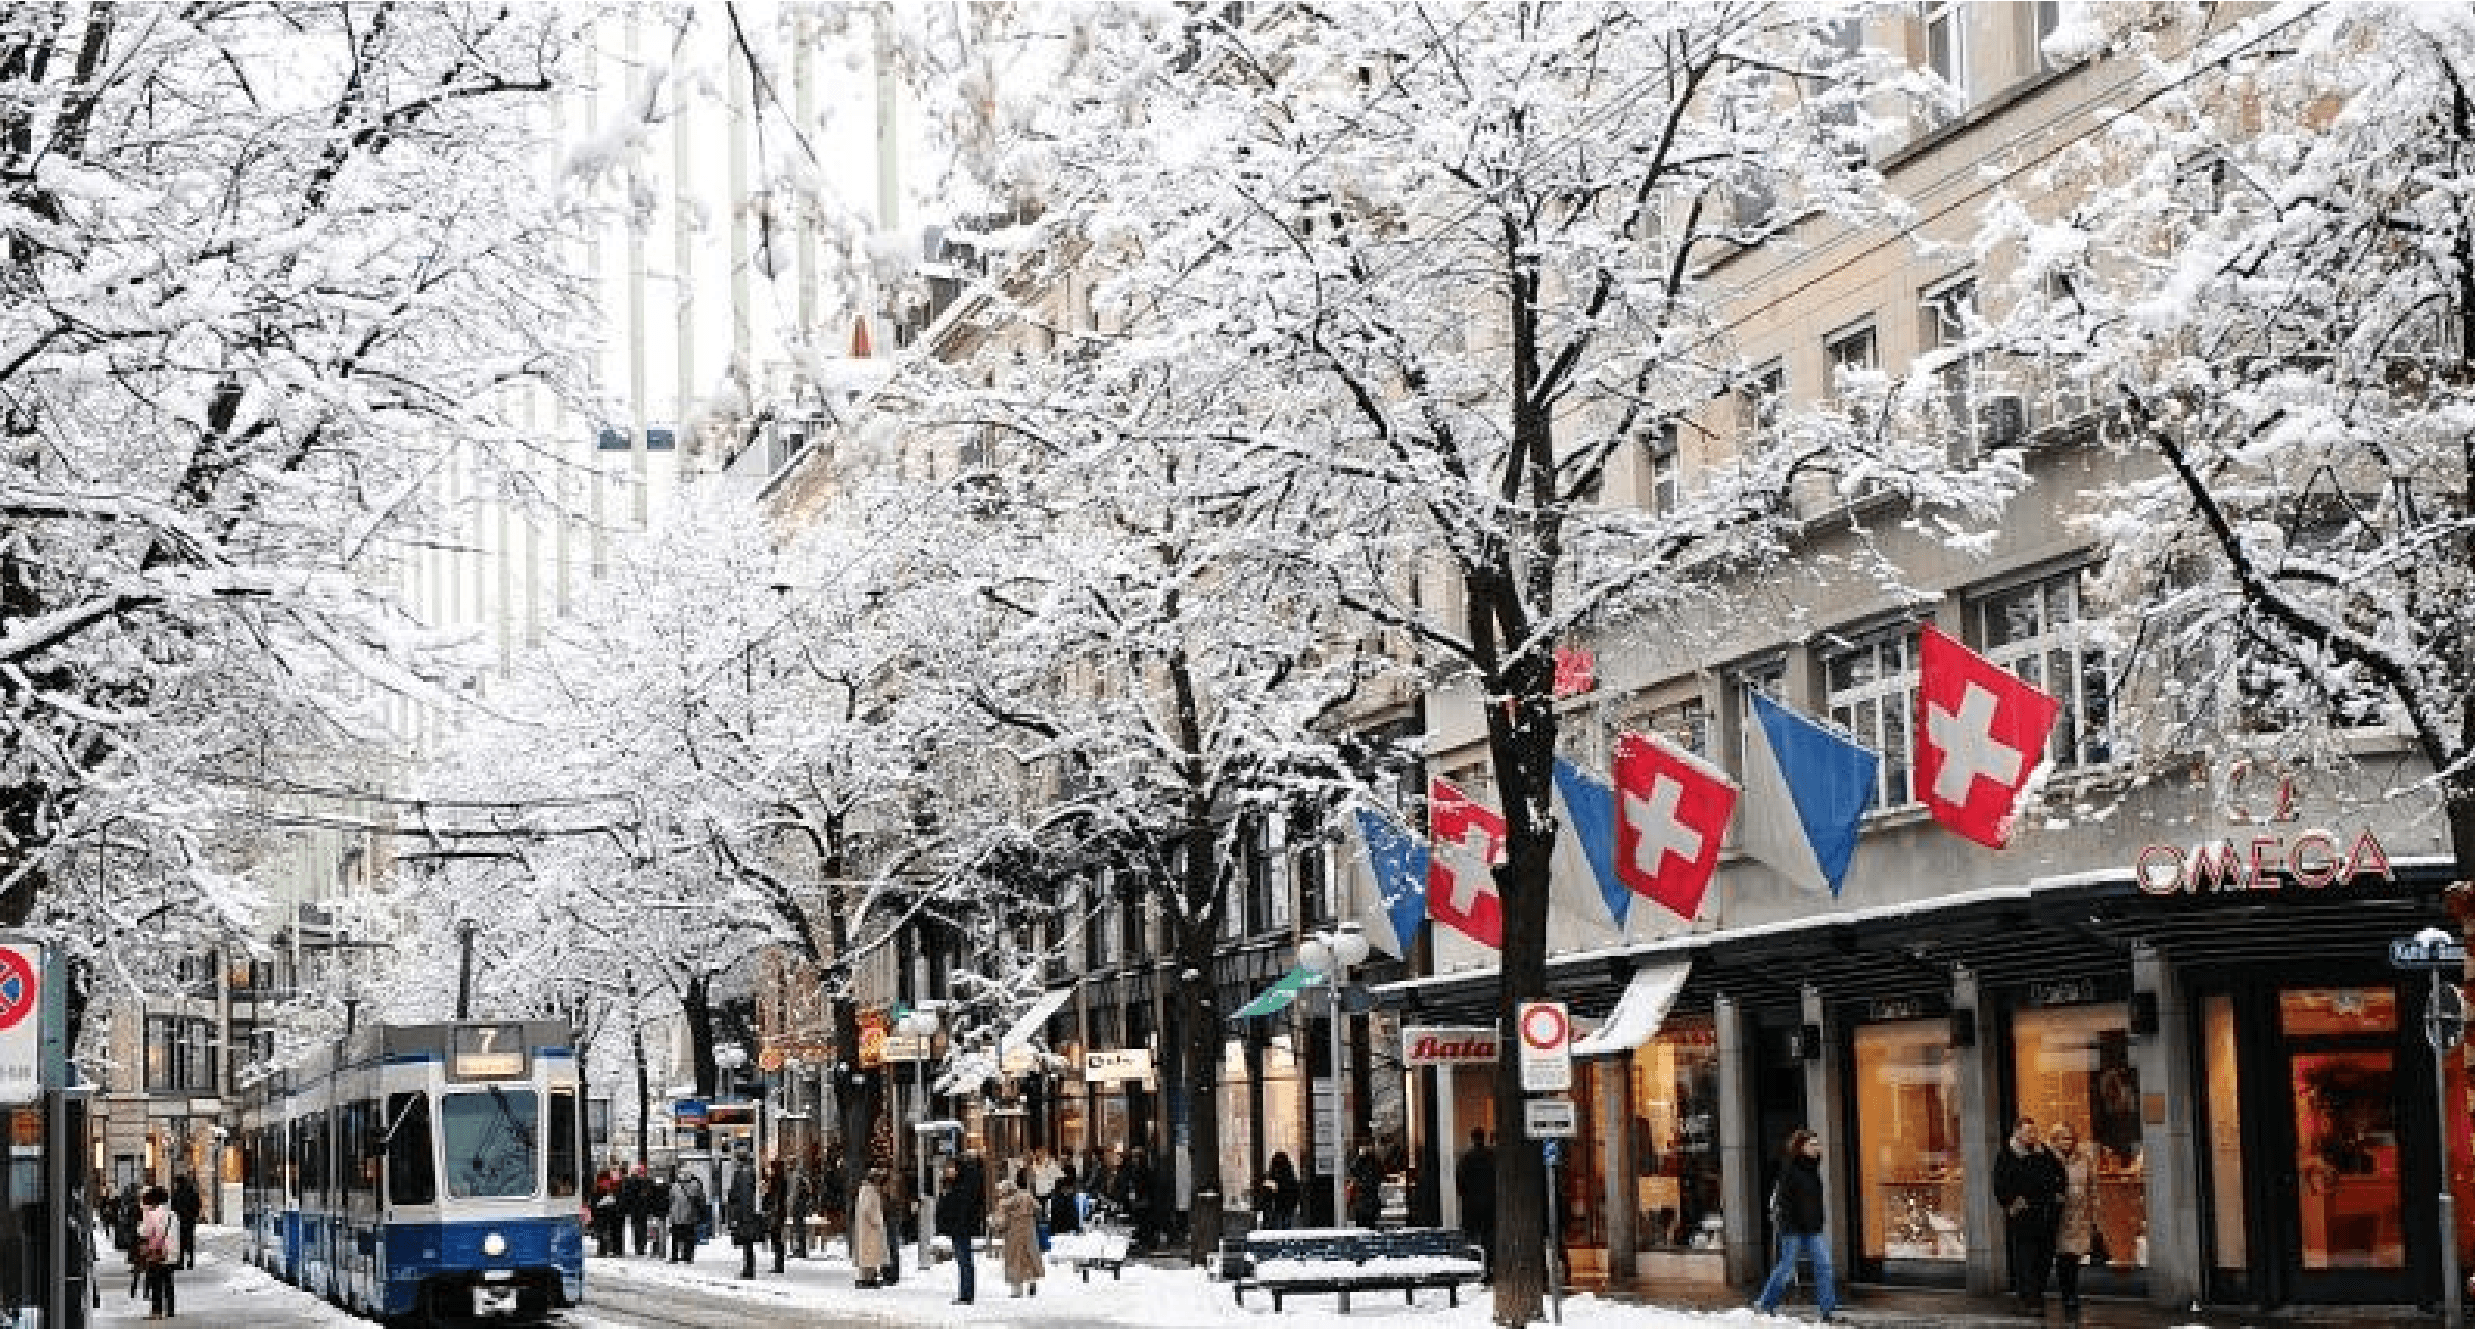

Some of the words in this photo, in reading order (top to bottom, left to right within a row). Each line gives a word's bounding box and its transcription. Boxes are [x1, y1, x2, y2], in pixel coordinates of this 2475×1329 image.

[2136, 831, 2391, 894] OMEGA
[478, 1027, 498, 1054] 7
[1411, 1035, 1495, 1060] Bata
